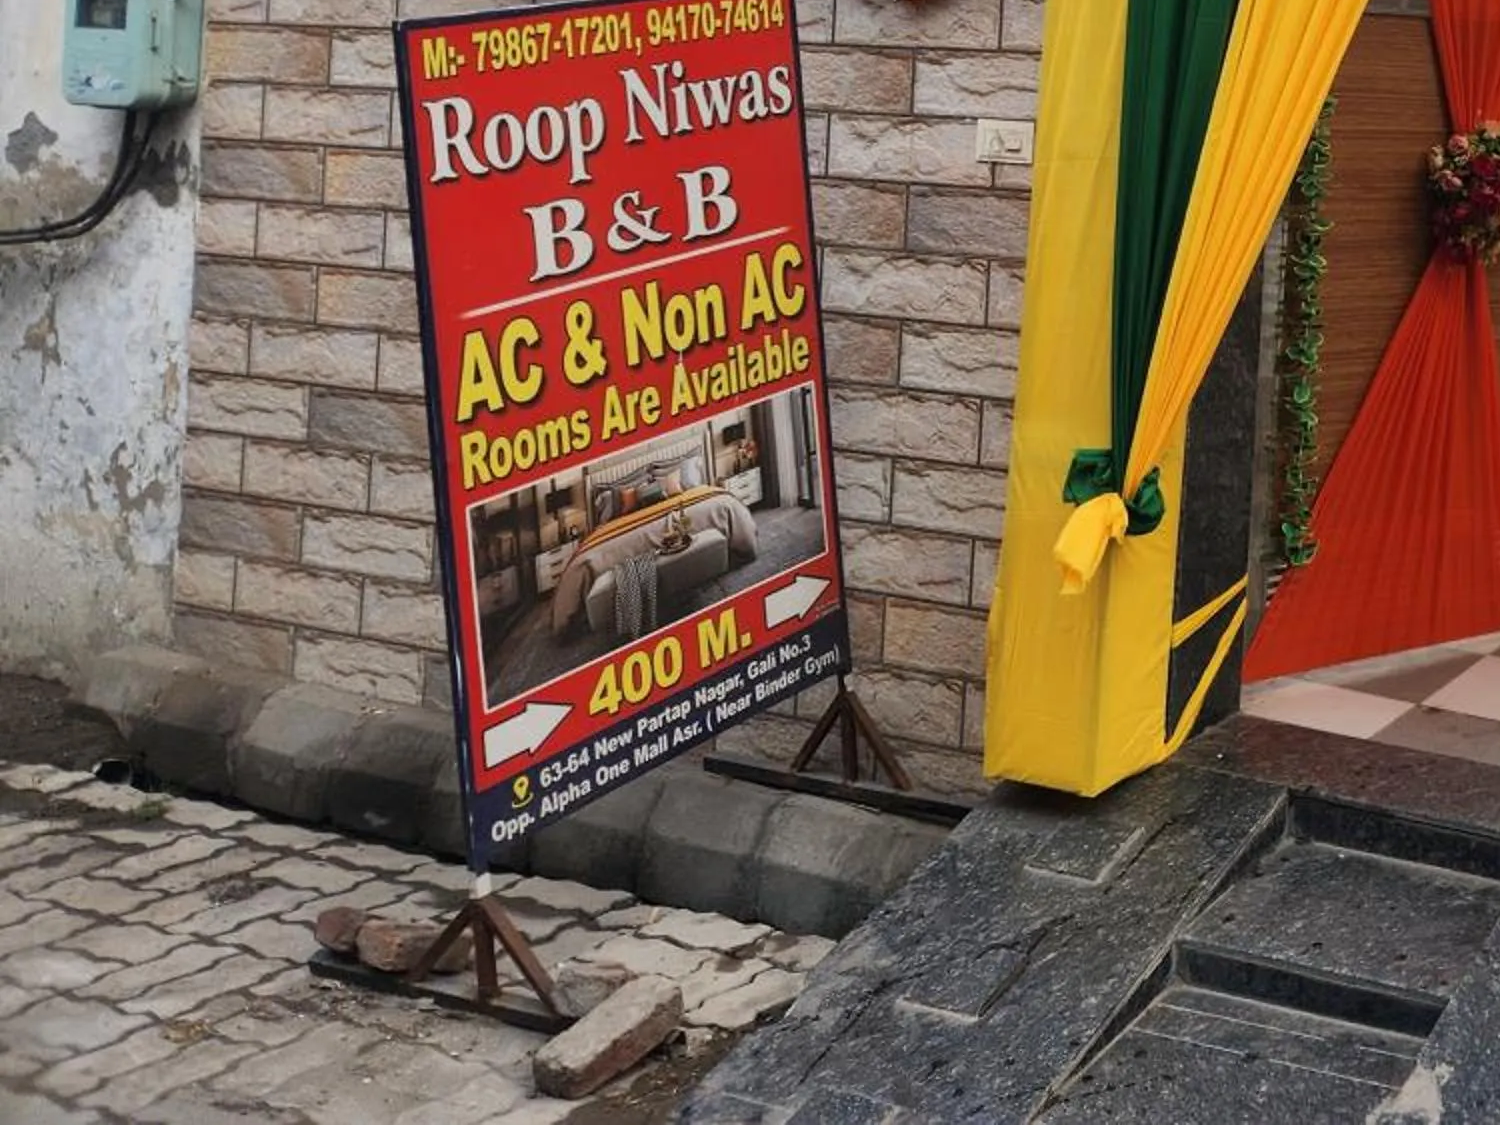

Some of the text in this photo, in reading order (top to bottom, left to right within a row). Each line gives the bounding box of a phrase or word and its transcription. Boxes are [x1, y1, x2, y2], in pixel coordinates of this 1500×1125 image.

[422, 35, 464, 79] M:-
[471, 12, 642, 73] 79867-17201,
[423, 60, 793, 185] Roop Niwas
[523, 165, 738, 282] B & B
[456, 242, 806, 423] AC & Non AC
[460, 328, 810, 491] Rooms Are Available
[539, 751, 591, 788] 63-64
[593, 729, 634, 759] New
[636, 699, 692, 740] Partap
[694, 673, 746, 710] Nagar,
[747, 654, 778, 681] Gali
[588, 607, 753, 717] 400 M.
[490, 815, 537, 844] Opp.
[539, 777, 592, 818] Alpha
[594, 759, 630, 787] One
[633, 740, 670, 767] Mall
[672, 720, 703, 747] Asr.
[716, 693, 752, 723] Near
[755, 668, 802, 700] Binder
[804, 645, 841, 674] Gym)
